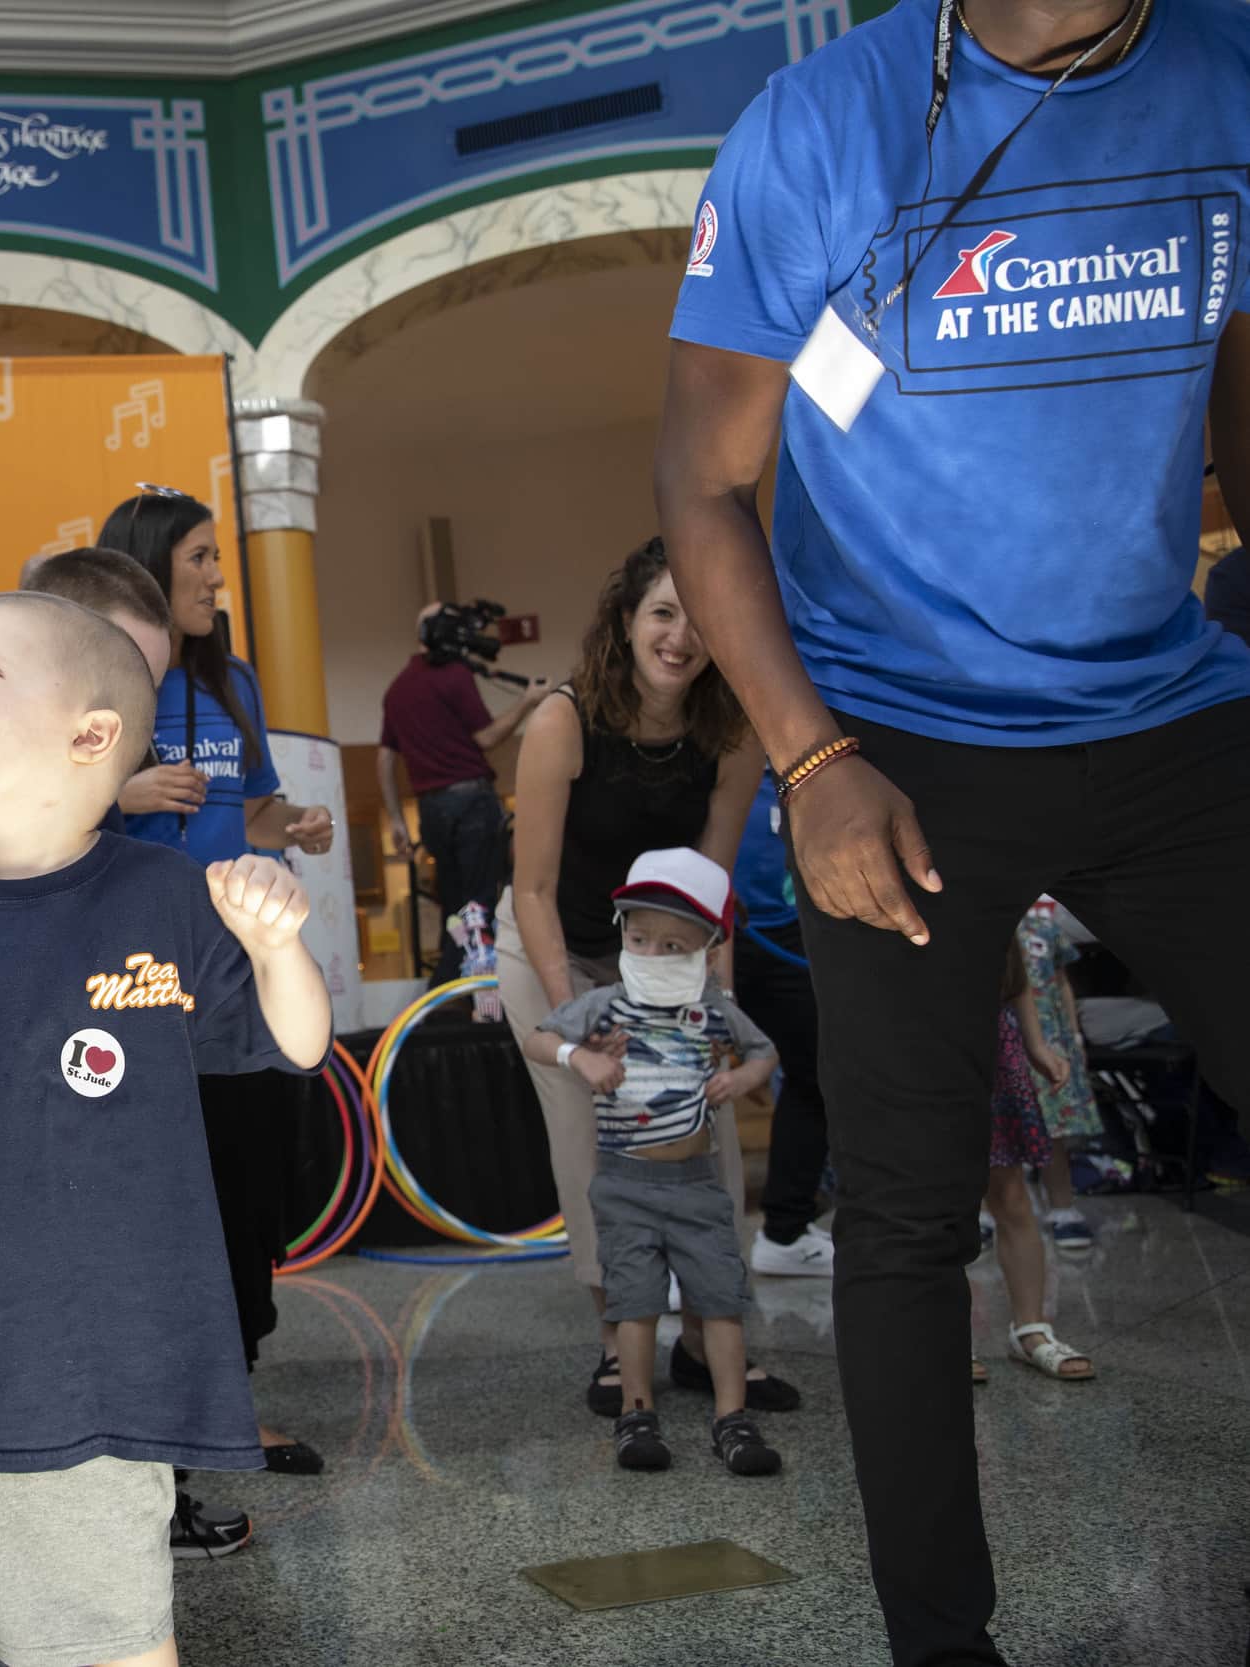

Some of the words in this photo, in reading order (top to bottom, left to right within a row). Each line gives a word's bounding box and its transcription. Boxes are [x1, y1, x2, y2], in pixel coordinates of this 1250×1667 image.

[994, 235, 1183, 292] Carnival
[1204, 212, 1230, 325] 08292018
[935, 306, 973, 341] AT
[982, 300, 1039, 336] THE
[1048, 285, 1185, 330] CARNIVAL
[66, 1067, 82, 1079] St.
[83, 1072, 112, 1088] Jude
[68, 1039, 88, 1068] I
